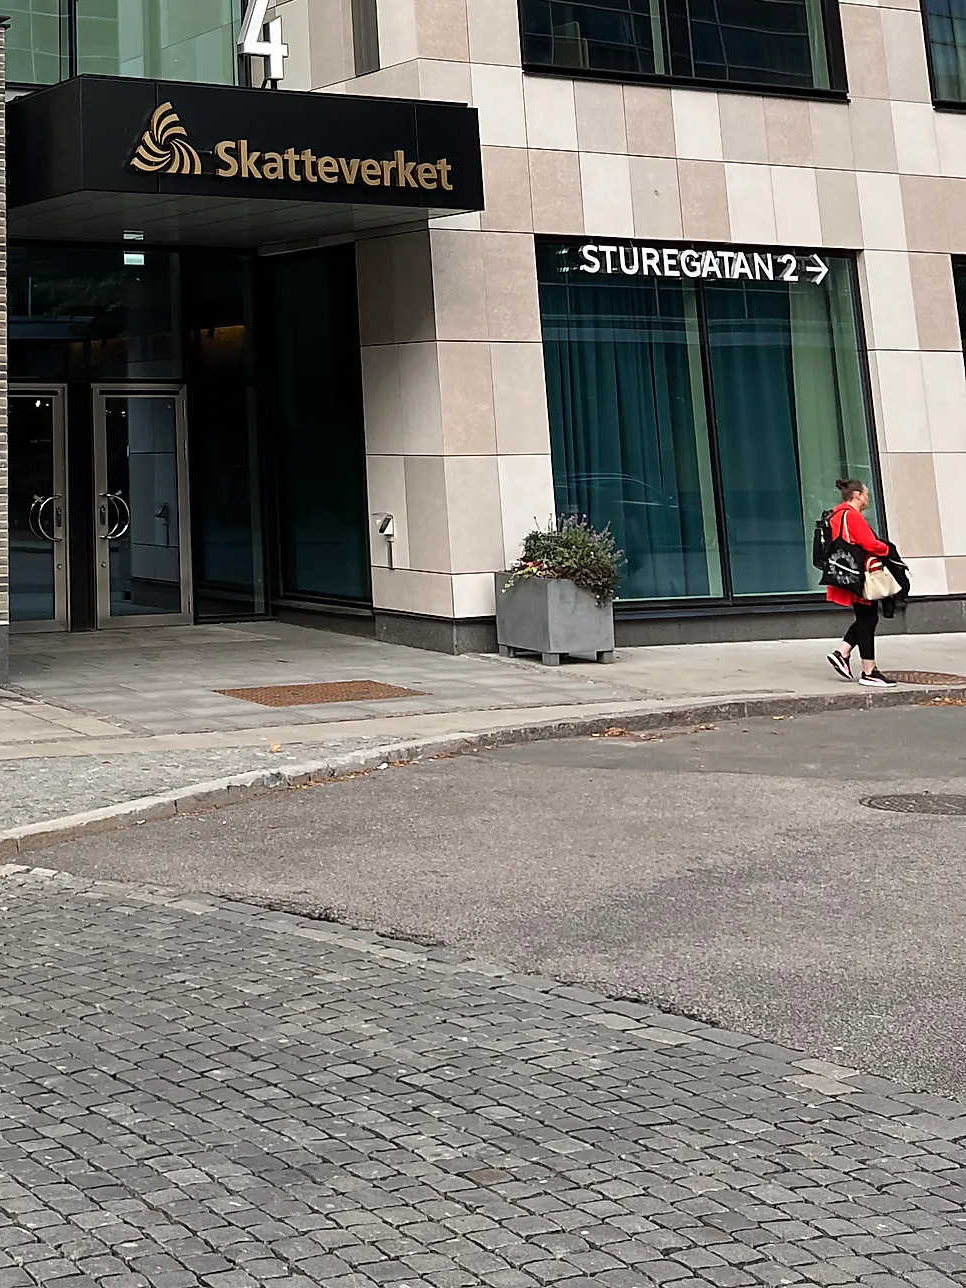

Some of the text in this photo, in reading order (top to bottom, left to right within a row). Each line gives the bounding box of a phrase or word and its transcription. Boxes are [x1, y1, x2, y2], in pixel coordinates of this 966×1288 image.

[214, 139, 453, 191] Skatteverket
[579, 244, 799, 282] STUREGATAN 2
